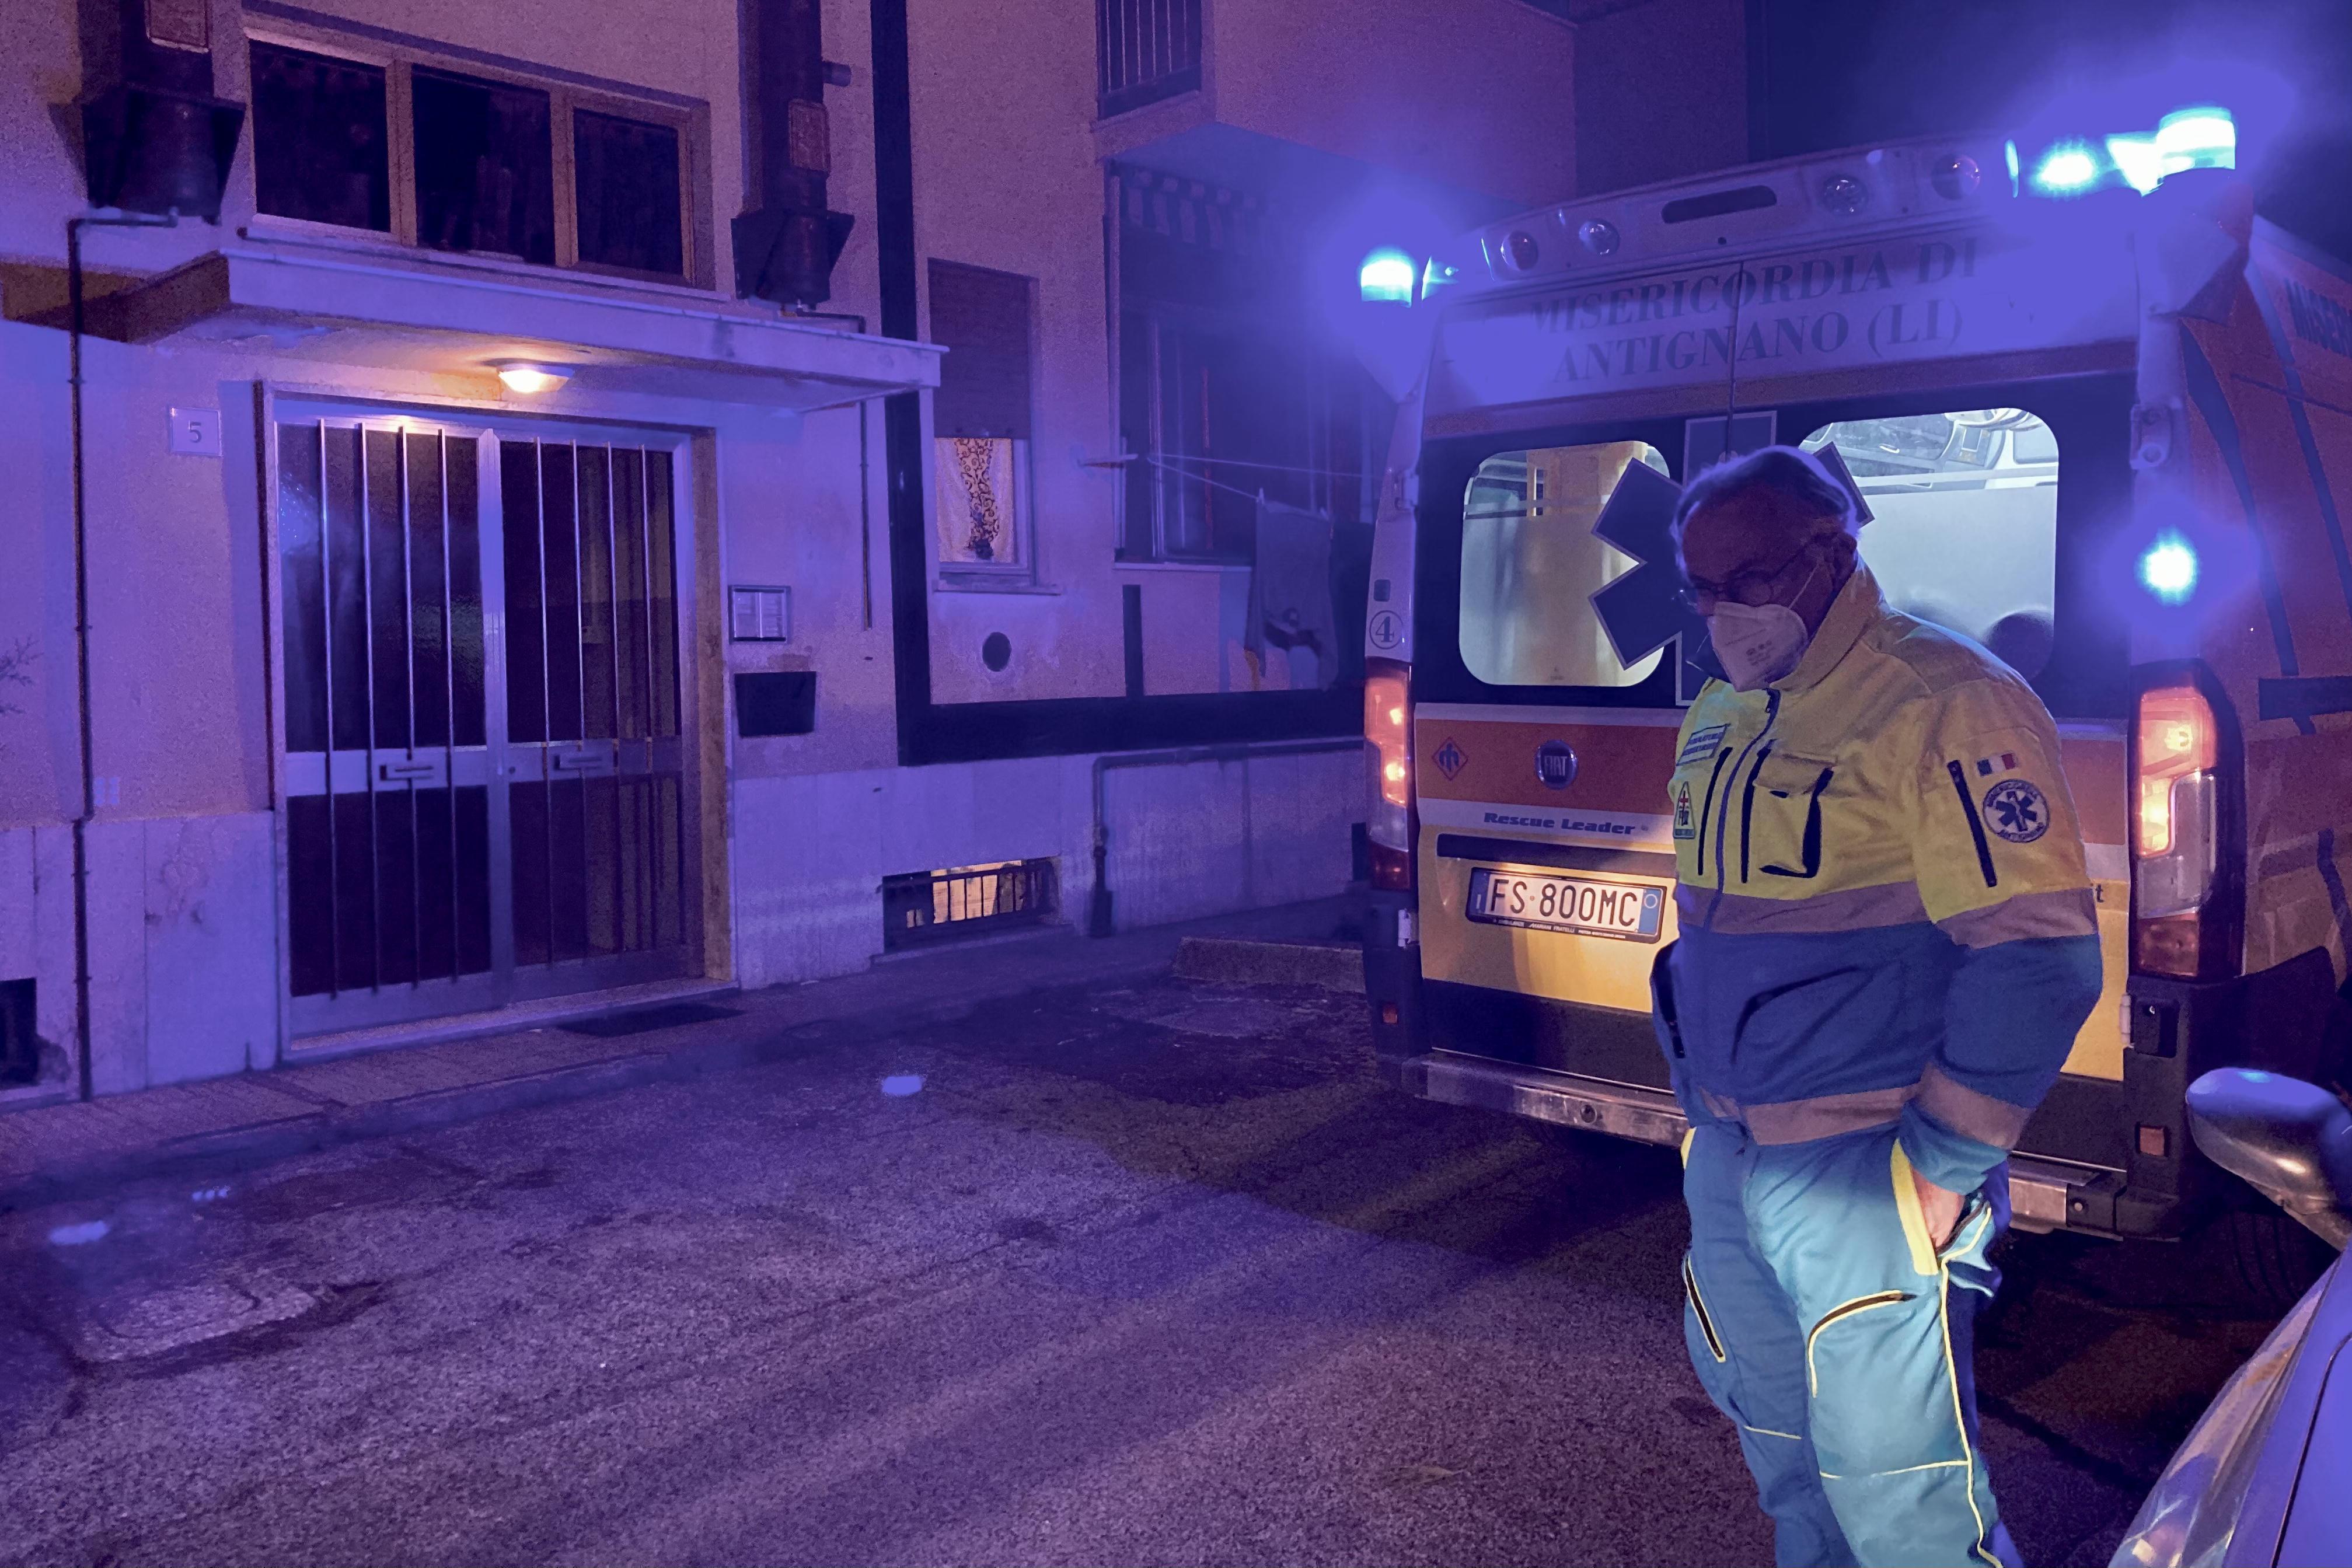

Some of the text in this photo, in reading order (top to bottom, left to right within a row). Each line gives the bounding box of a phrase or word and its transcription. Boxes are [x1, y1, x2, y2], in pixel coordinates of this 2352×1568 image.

[1530, 236, 1978, 333] MISERICORDIA DI
[1552, 298, 1963, 383] ANTIGNANO (LI)
[188, 420, 202, 443] 5
[1375, 616, 1406, 642] 4
[1544, 755, 1568, 776] FIAT
[1484, 812, 1635, 834] Rescue Leader
[1491, 879, 1638, 927] FS 800MC
